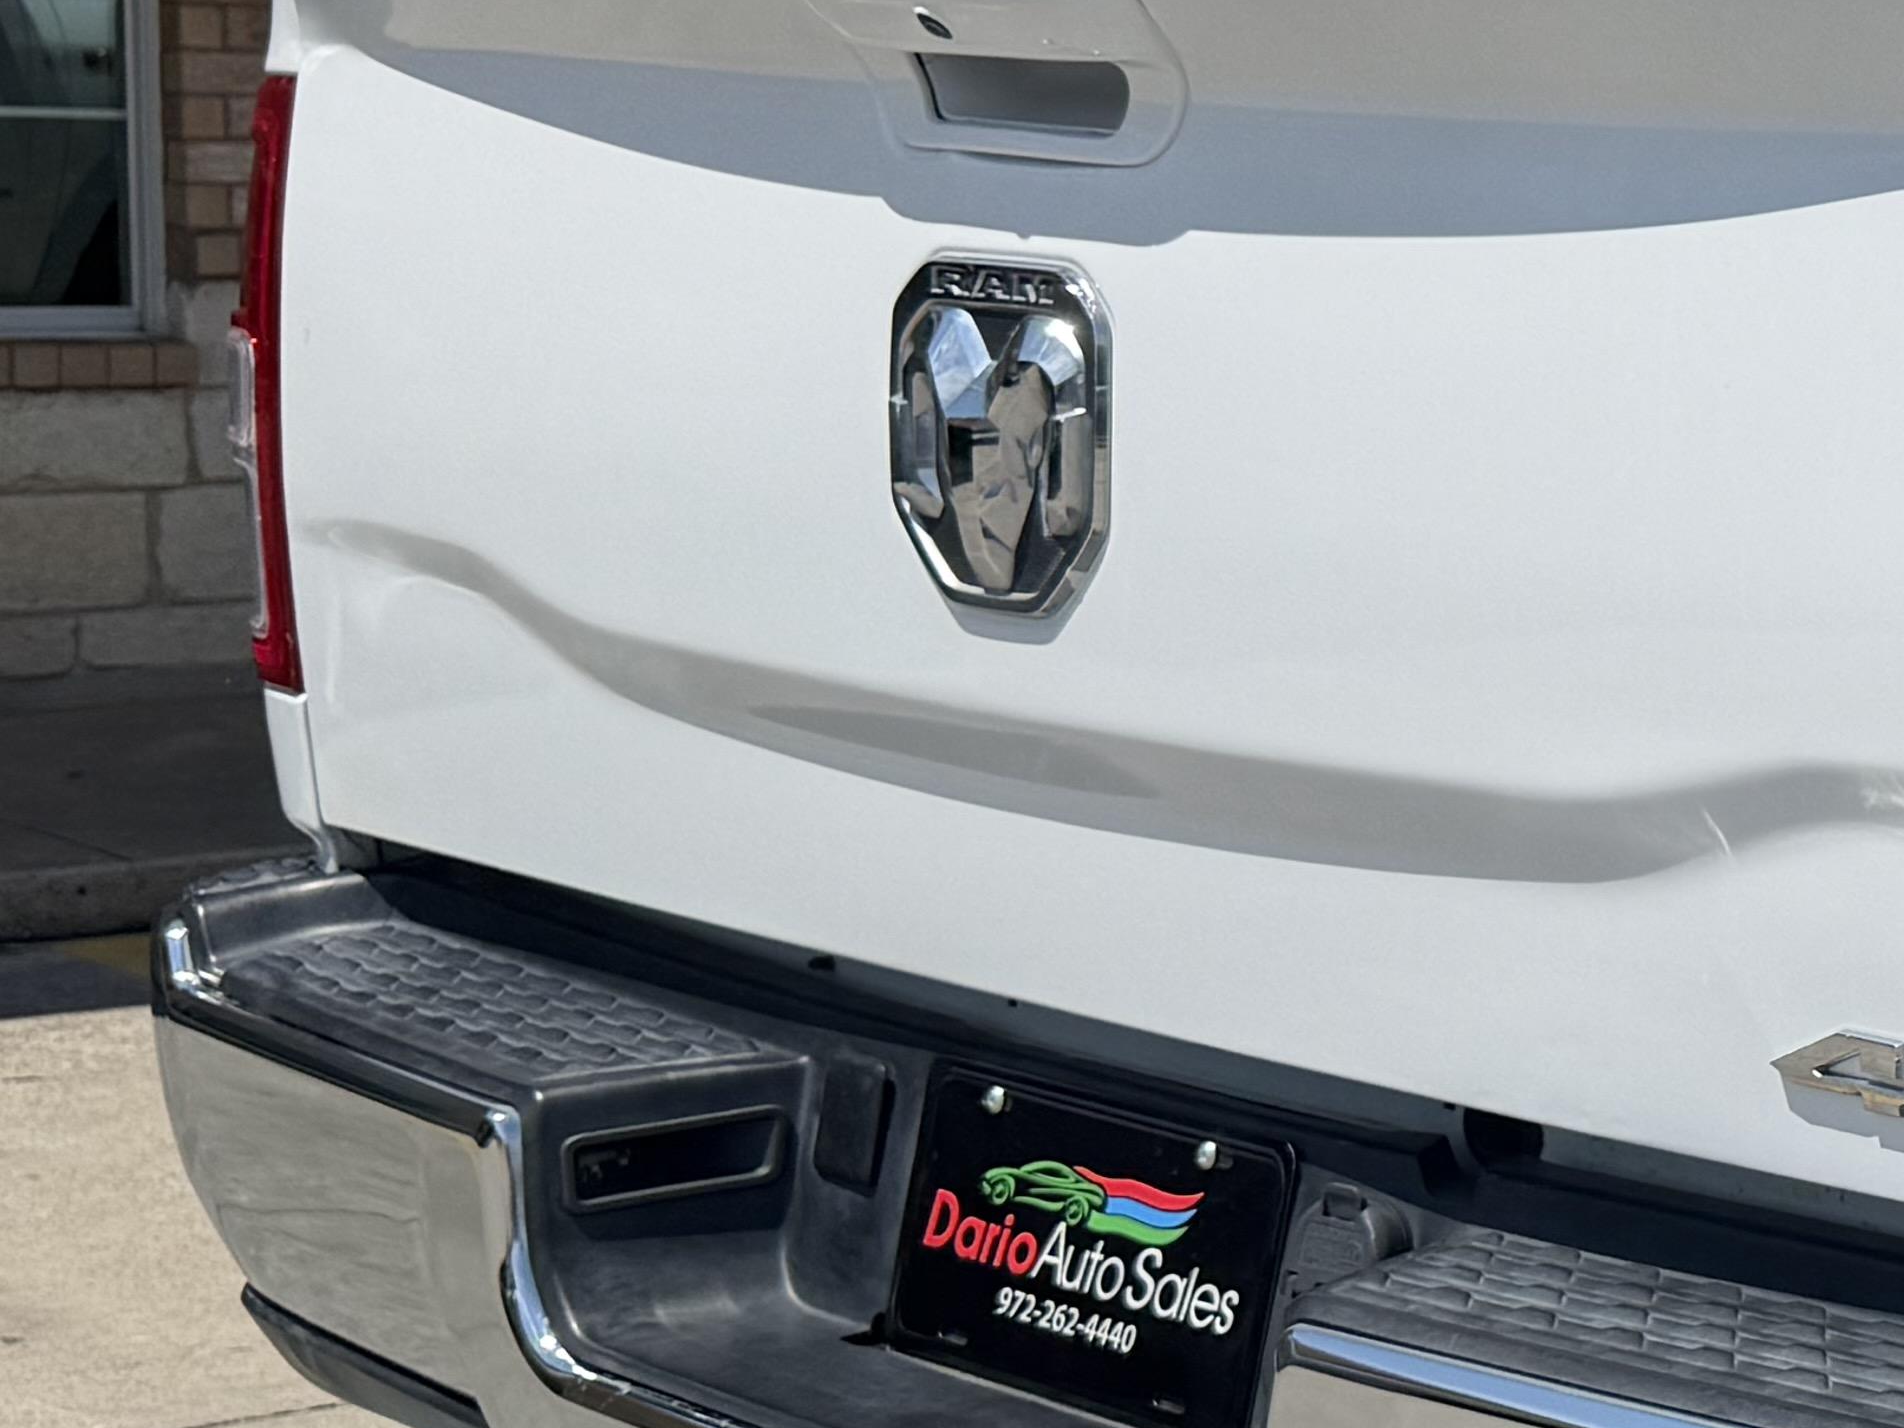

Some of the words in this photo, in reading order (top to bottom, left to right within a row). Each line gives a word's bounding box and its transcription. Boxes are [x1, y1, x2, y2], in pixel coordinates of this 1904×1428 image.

[930, 265, 1056, 306] RAM
[922, 1189, 1040, 1276] Dario
[1027, 1221, 1126, 1303] Auto
[1122, 1247, 1240, 1337] Sales
[994, 1286, 1138, 1355] 972-262-4440
